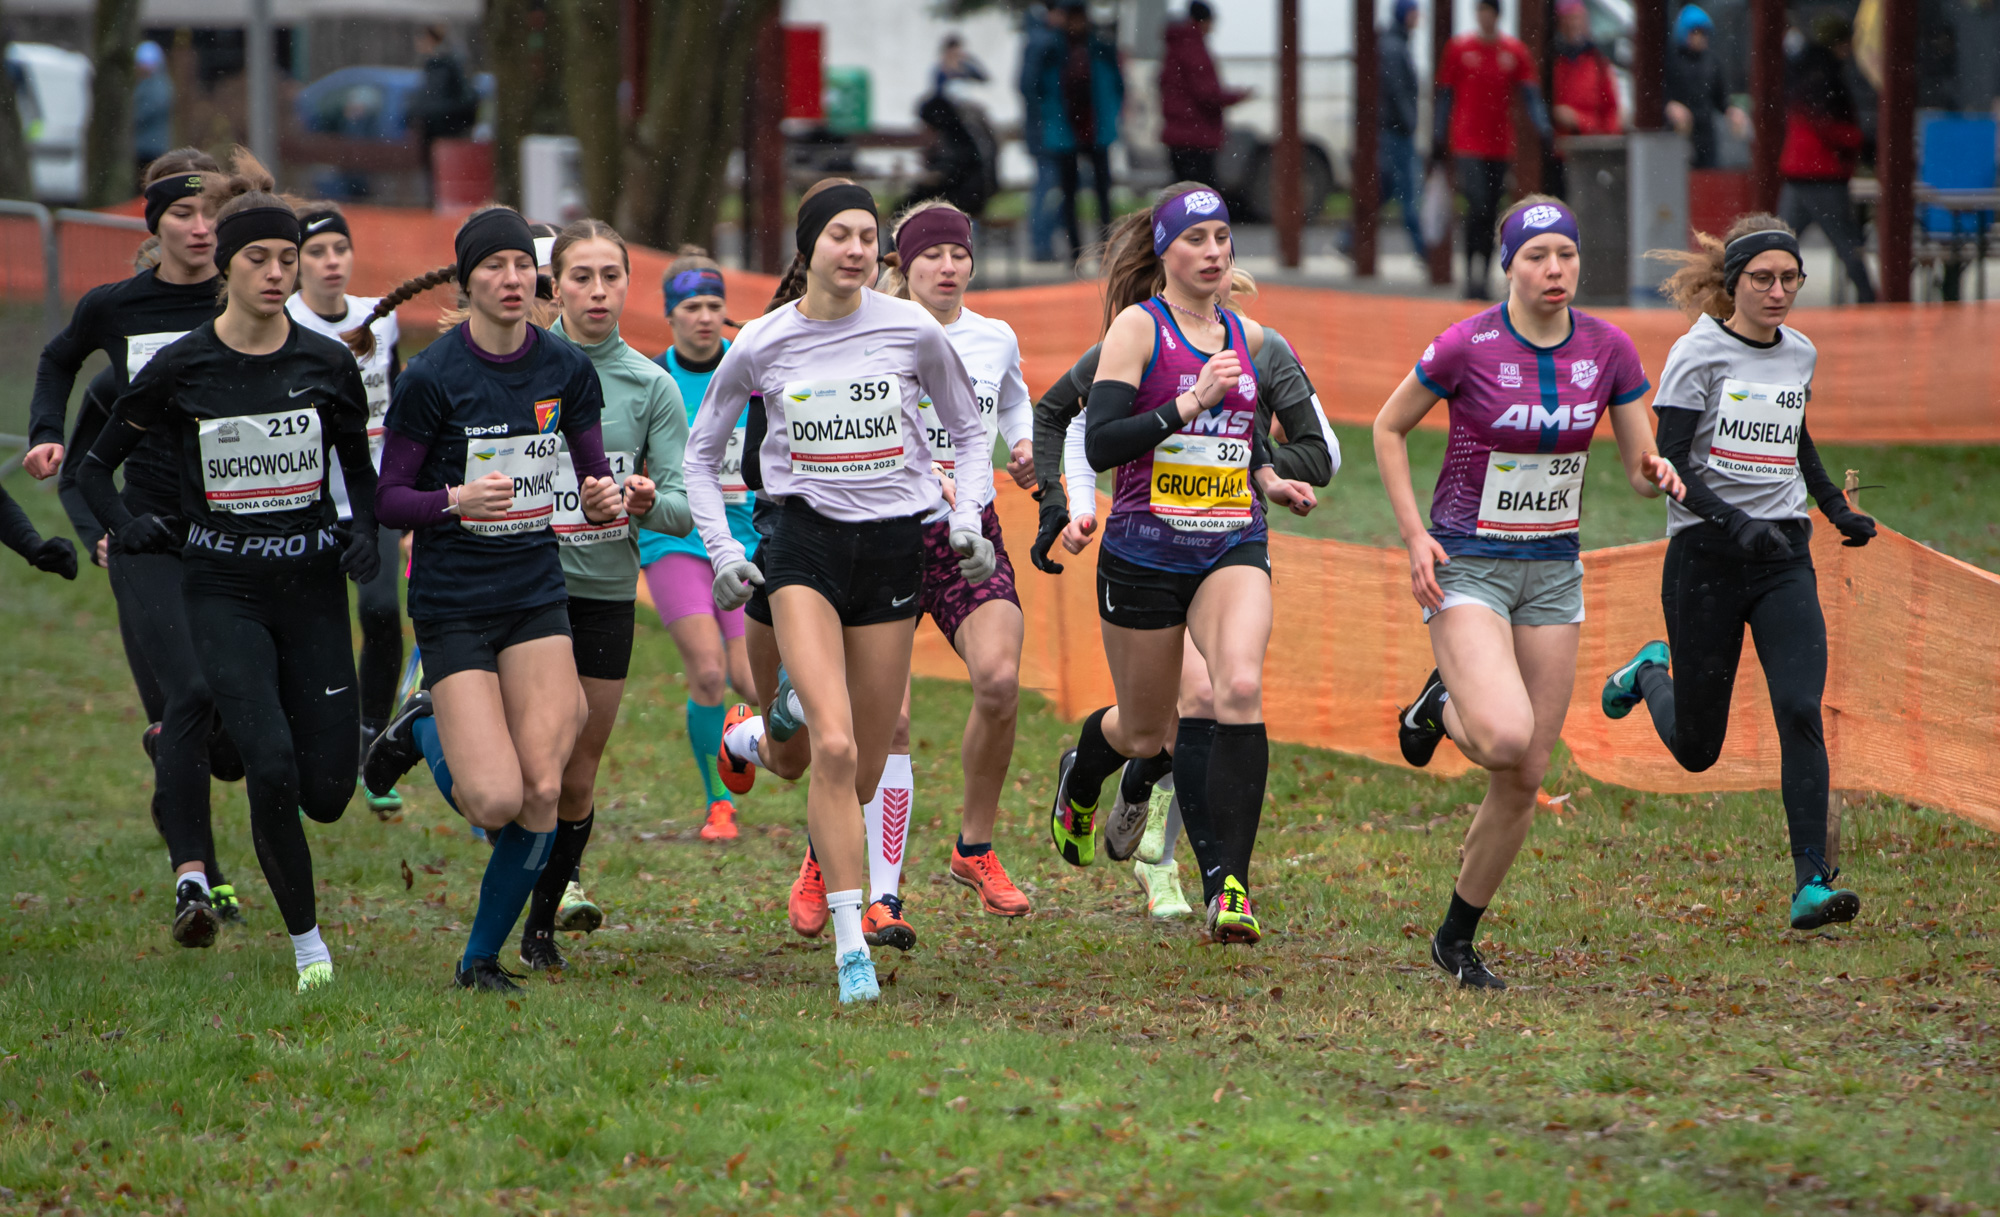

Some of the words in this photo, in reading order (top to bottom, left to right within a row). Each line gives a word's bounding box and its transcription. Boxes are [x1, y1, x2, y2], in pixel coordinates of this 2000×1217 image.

[1471, 329, 1500, 344] deep
[1504, 365, 1516, 375] KB
[1570, 365, 1599, 384] AMS
[1183, 376, 1194, 386] KB
[849, 380, 890, 402] 359
[1776, 391, 1803, 409] 485
[1490, 401, 1598, 430] AMS
[267, 414, 310, 438] 219
[792, 413, 897, 442] DOMŻALSKA
[524, 438, 556, 459] 463
[1217, 442, 1245, 462] 327
[208, 448, 319, 479] SUCHOWOLAK
[801, 463, 840, 473] ZIELONA
[842, 462, 871, 473] GÓRA
[873, 459, 896, 470] 2023
[1549, 456, 1580, 476] 326
[1716, 459, 1754, 472] ZIELONA
[1755, 464, 1778, 474] GÓRA
[1156, 473, 1248, 498] GRUCHAŁA
[262, 497, 293, 508] GÓRA
[1496, 488, 1571, 512] BIAŁEK
[470, 523, 509, 533] ZIELONA
[511, 520, 534, 531] GÓRA
[535, 517, 550, 528] 2023
[1139, 524, 1161, 538] MG
[1160, 517, 1198, 528] IELONA
[1200, 519, 1225, 528] GÓRA
[1226, 520, 1246, 528] 2023
[573, 532, 600, 542] GÓRA
[601, 529, 622, 539] 2023
[240, 534, 306, 557] PRO
